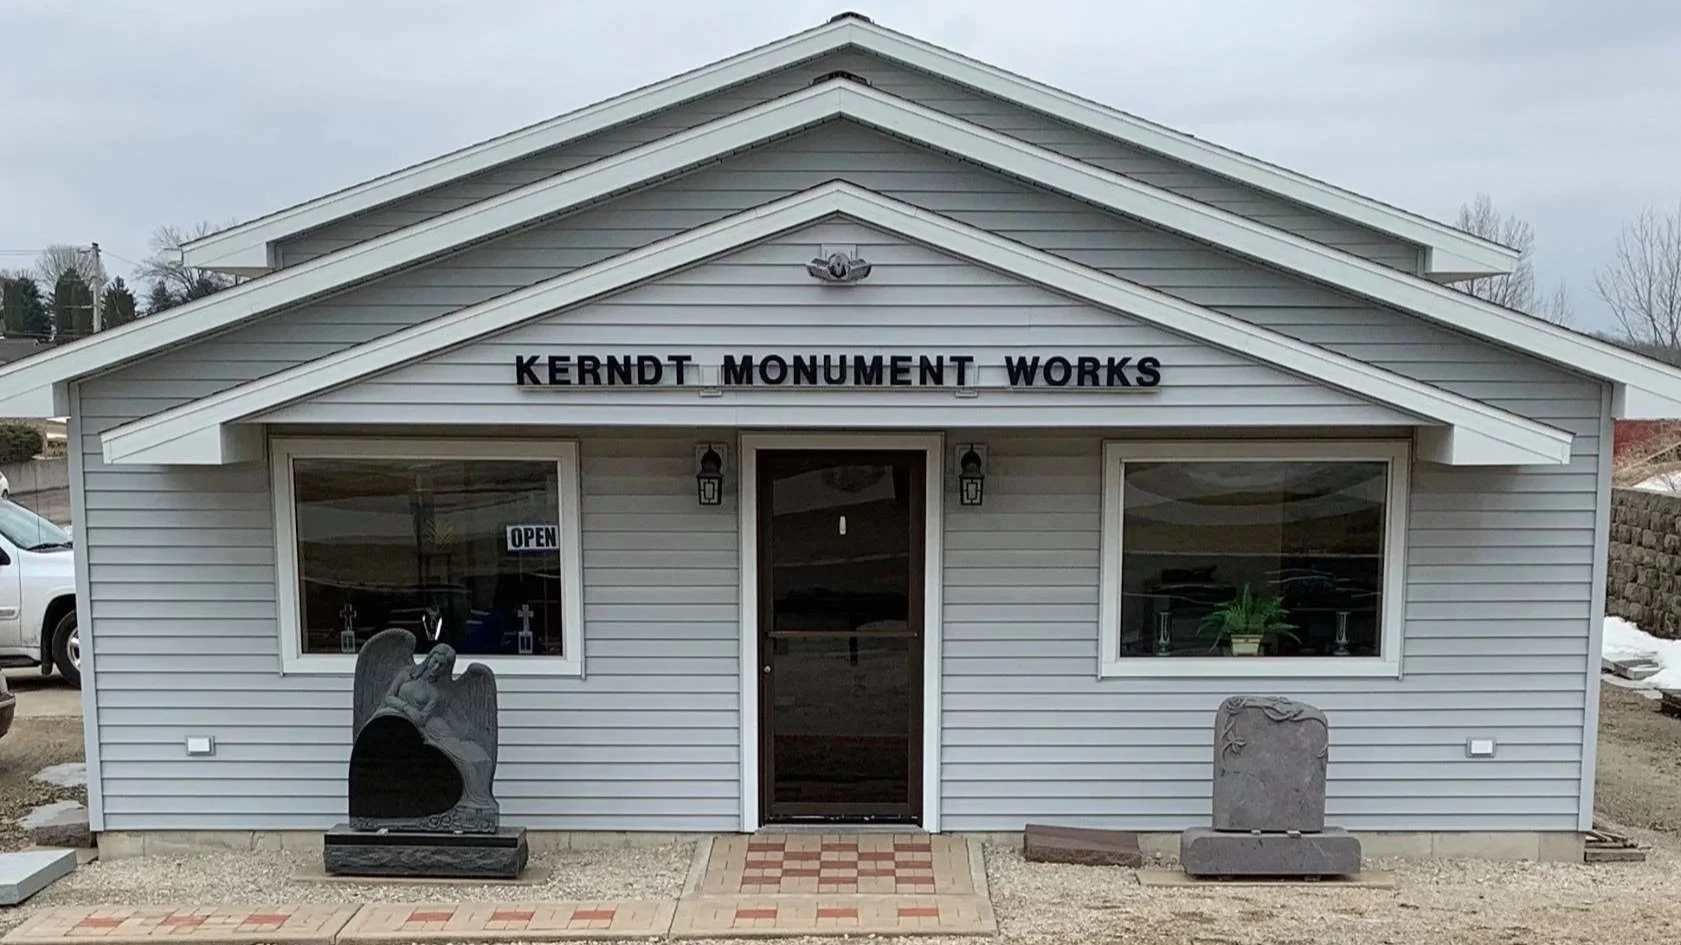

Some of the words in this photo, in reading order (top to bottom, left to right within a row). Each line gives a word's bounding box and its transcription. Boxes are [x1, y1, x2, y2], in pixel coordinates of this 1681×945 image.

[516, 355, 691, 386] KERNDT
[724, 355, 974, 386] MONUMENT
[1005, 356, 1161, 387] WORKS
[511, 527, 557, 548] OPEN
